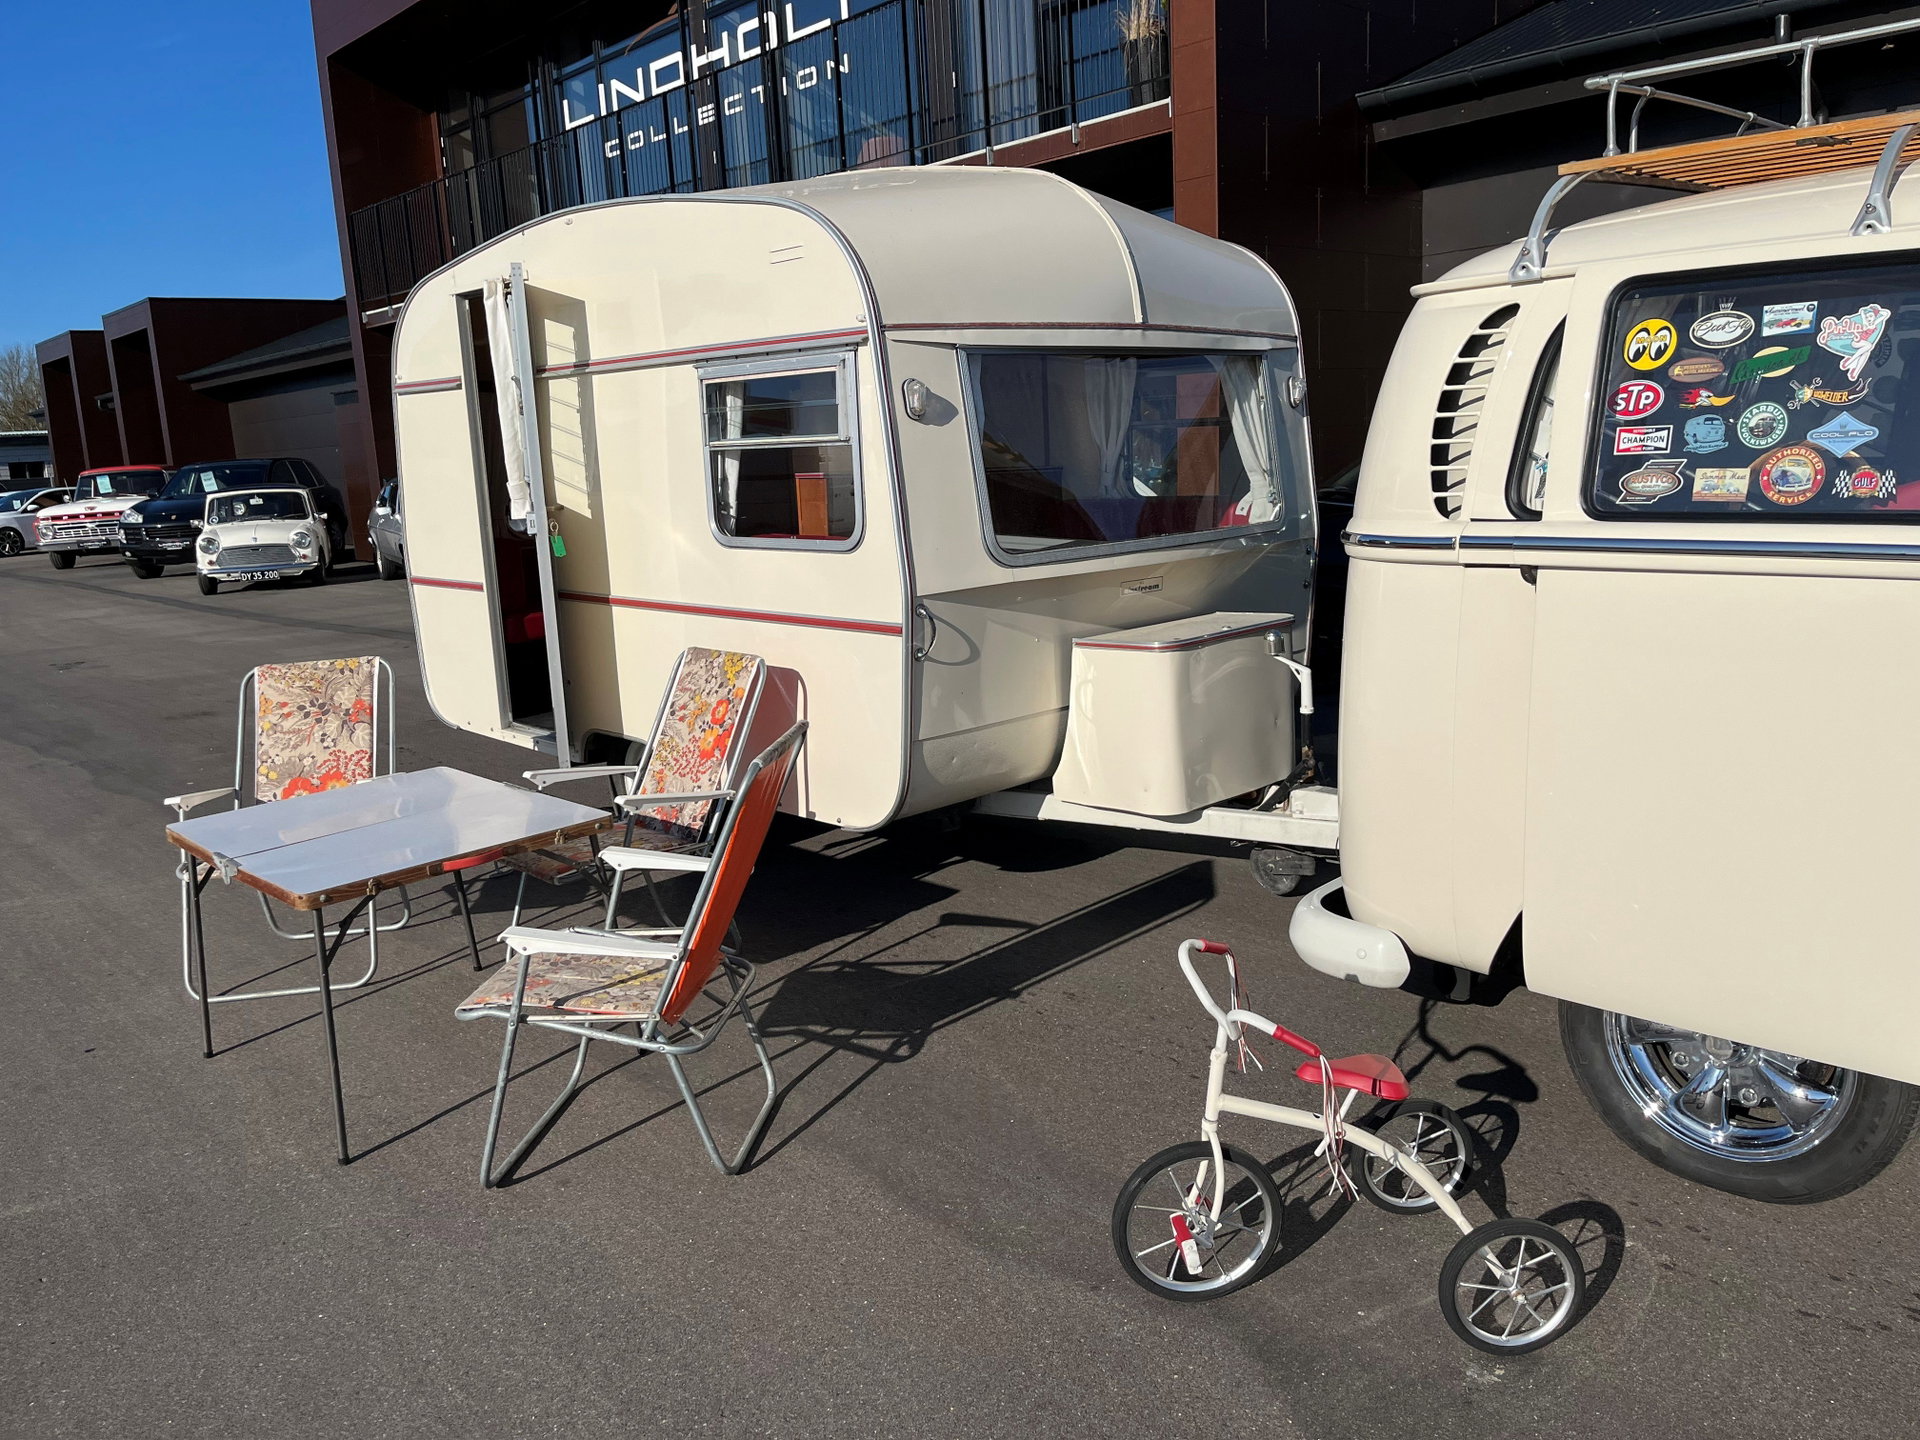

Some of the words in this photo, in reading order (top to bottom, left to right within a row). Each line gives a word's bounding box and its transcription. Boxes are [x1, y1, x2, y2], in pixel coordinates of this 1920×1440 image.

[604, 52, 850, 159] COLLECTION
[1635, 334, 1668, 345] MOON
[1615, 384, 1655, 412] STP
[1742, 404, 1785, 424] STARBUS
[1622, 435, 1665, 445] CHAMPION
[1740, 423, 1785, 446] VOLKSWAGEN
[1812, 431, 1844, 439] COOL
[1765, 447, 1822, 471] AUTHORIZED
[1854, 477, 1877, 489] GULF
[1767, 489, 1813, 504] SERVICE
[241, 573, 251, 581] DY
